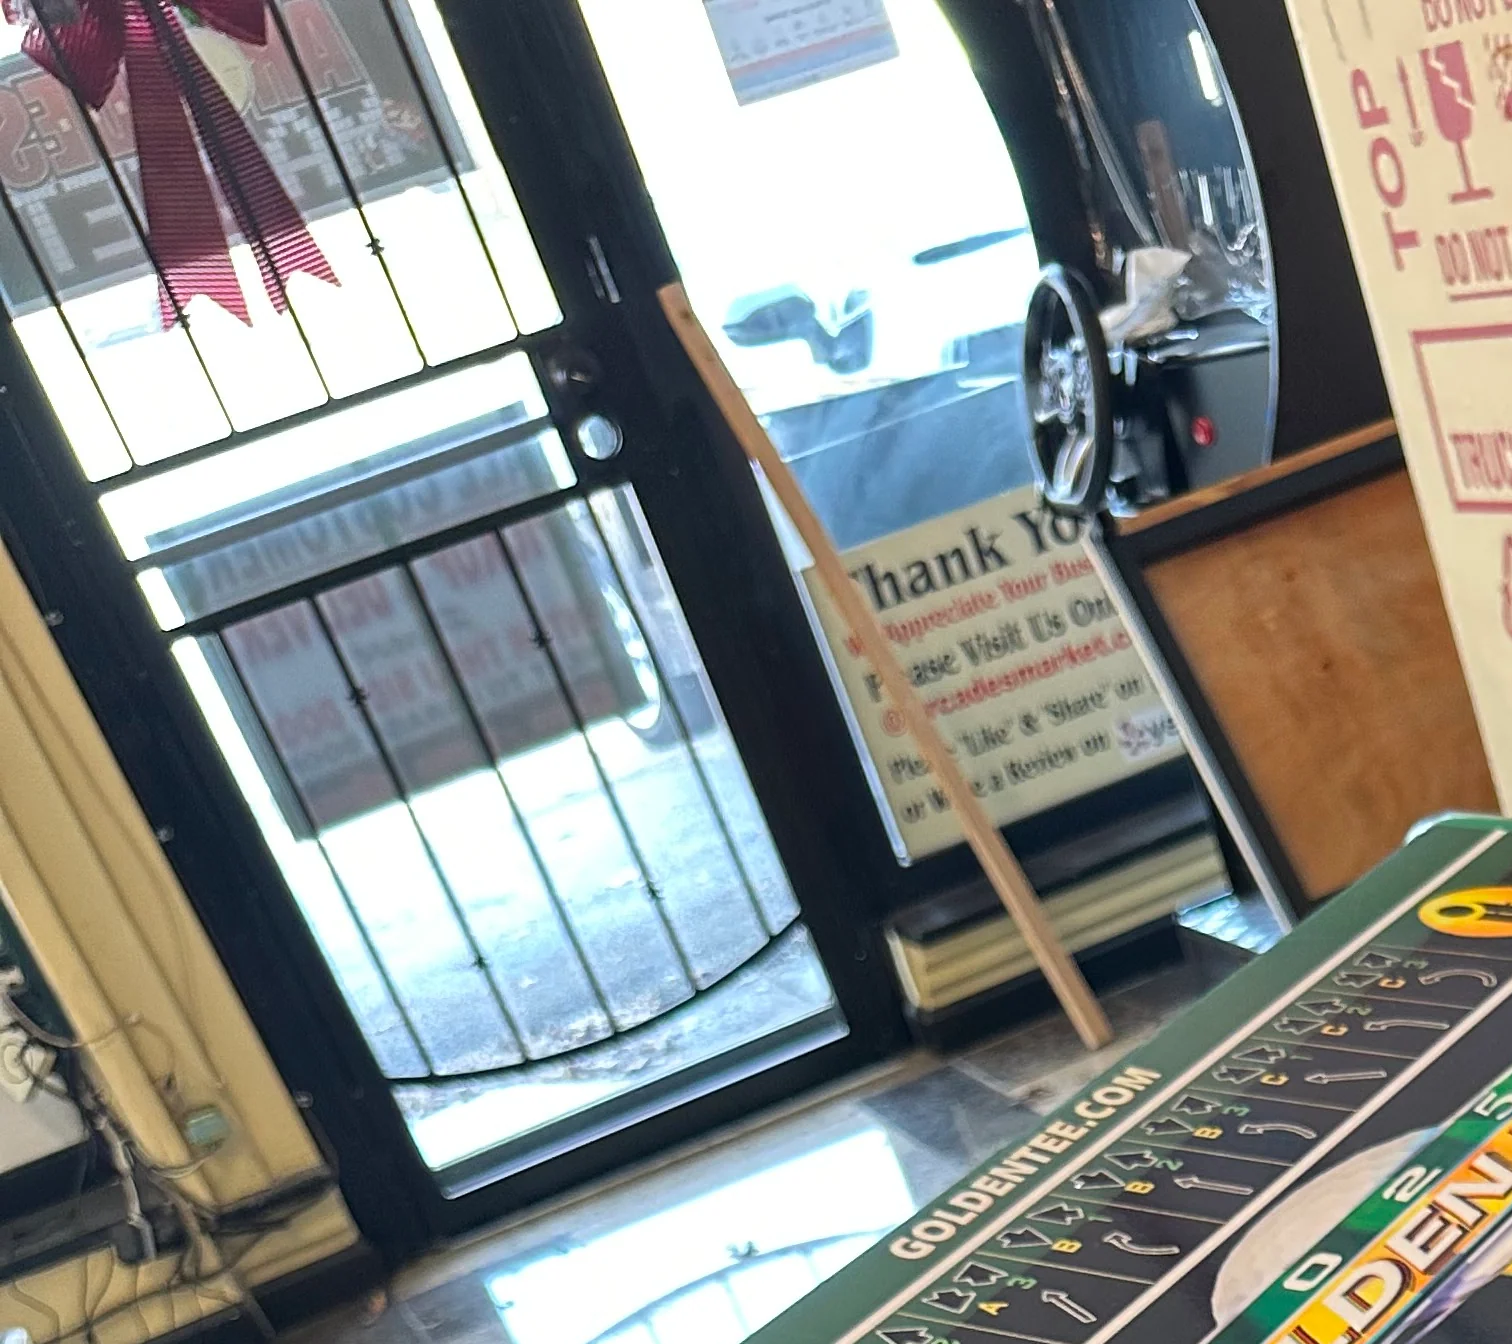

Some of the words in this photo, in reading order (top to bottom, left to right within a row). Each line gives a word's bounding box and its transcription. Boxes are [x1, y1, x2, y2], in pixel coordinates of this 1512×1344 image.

[1351, 68, 1420, 271] TOP
[1434, 233, 1470, 286] DO
[1403, 957, 1429, 970] 3
[1378, 976, 1406, 989] C
[1346, 1004, 1372, 1016] 2
[1320, 1023, 1349, 1037] C
[1259, 1073, 1290, 1086] C
[1222, 1105, 1250, 1117] 3
[1193, 1125, 1223, 1140] B
[888, 1066, 1162, 1263] GOLDENTEE.COM
[1153, 1157, 1184, 1172] 2
[1125, 1180, 1154, 1195] B
[1051, 1237, 1082, 1254] B
[1007, 1275, 1038, 1291] 3
[978, 1299, 1010, 1317] A
